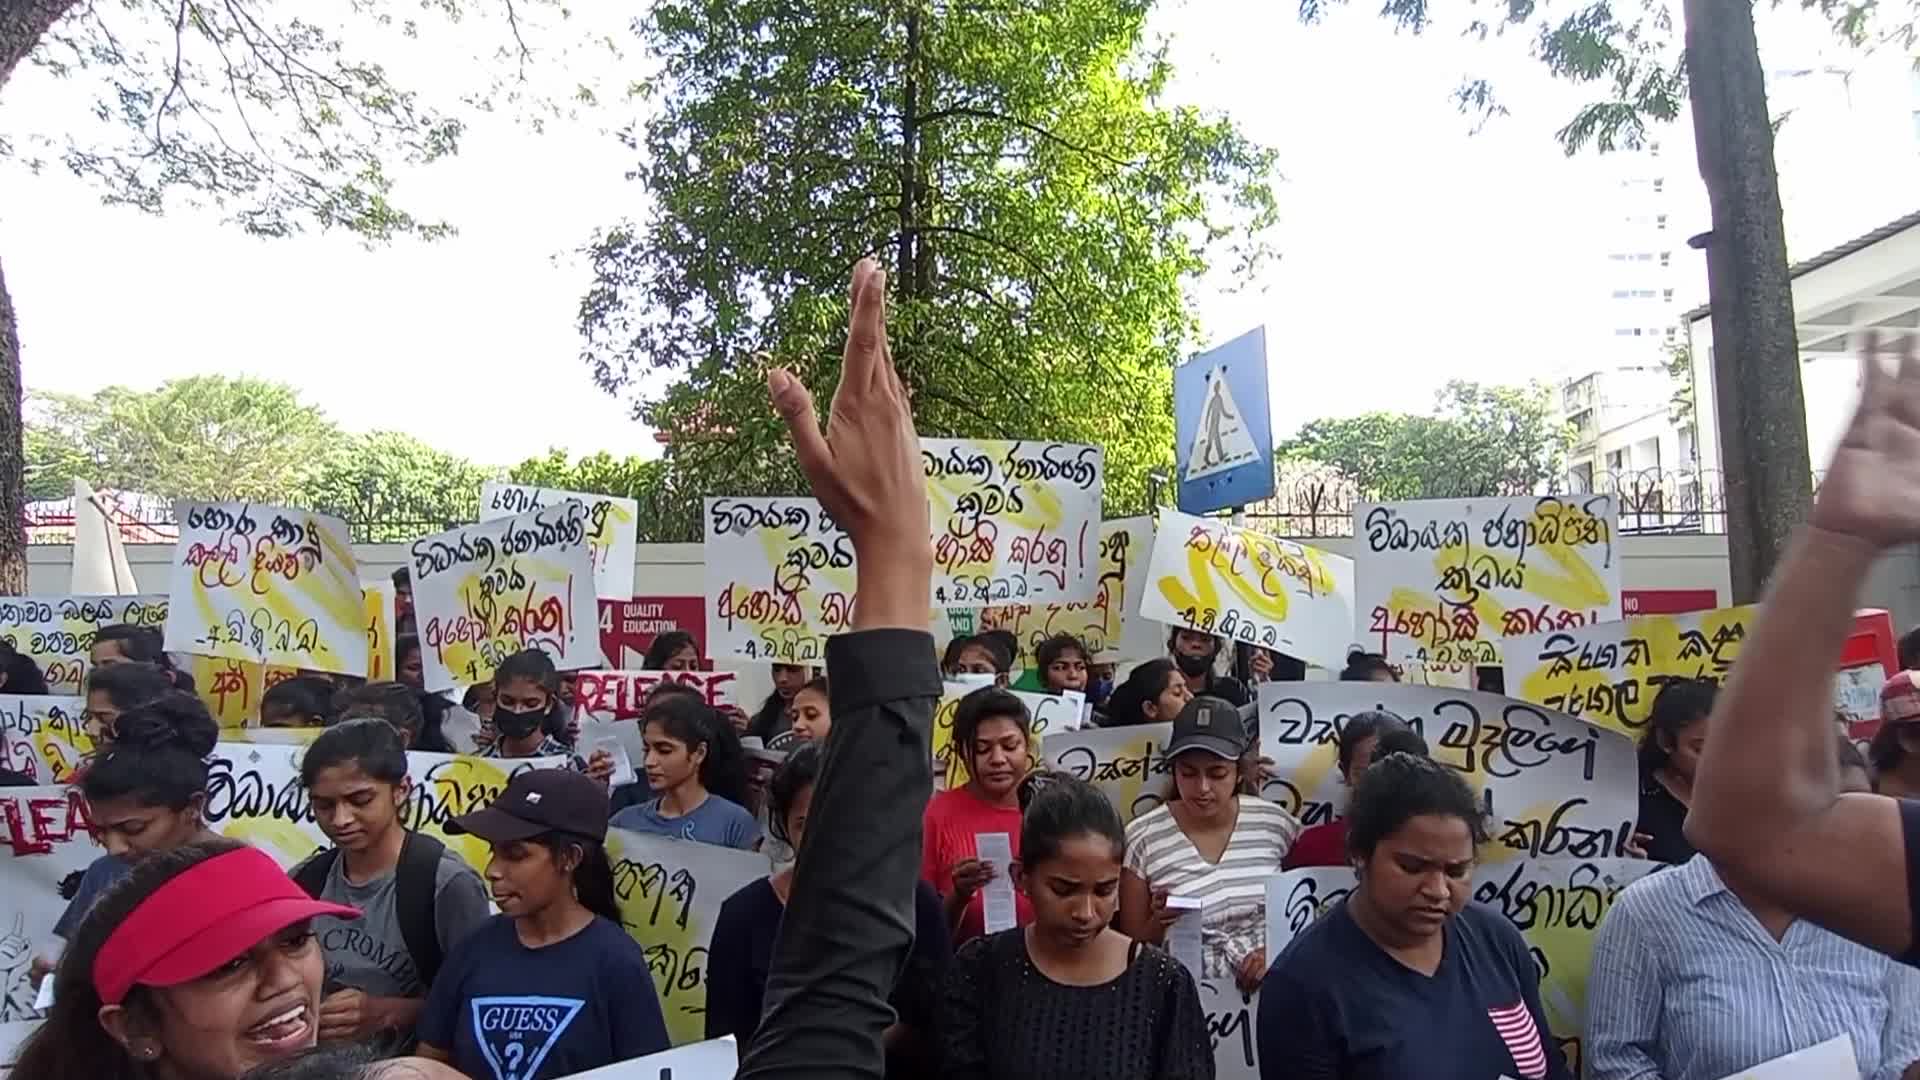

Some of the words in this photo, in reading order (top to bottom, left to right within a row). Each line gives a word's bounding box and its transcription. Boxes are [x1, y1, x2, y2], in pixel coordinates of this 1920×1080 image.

[623, 604, 664, 618] QUALITY
[1624, 597, 1639, 612] NO
[600, 604, 614, 634] 4
[623, 620, 678, 634] EDUCATION
[482, 1006, 559, 1032] GUESS
